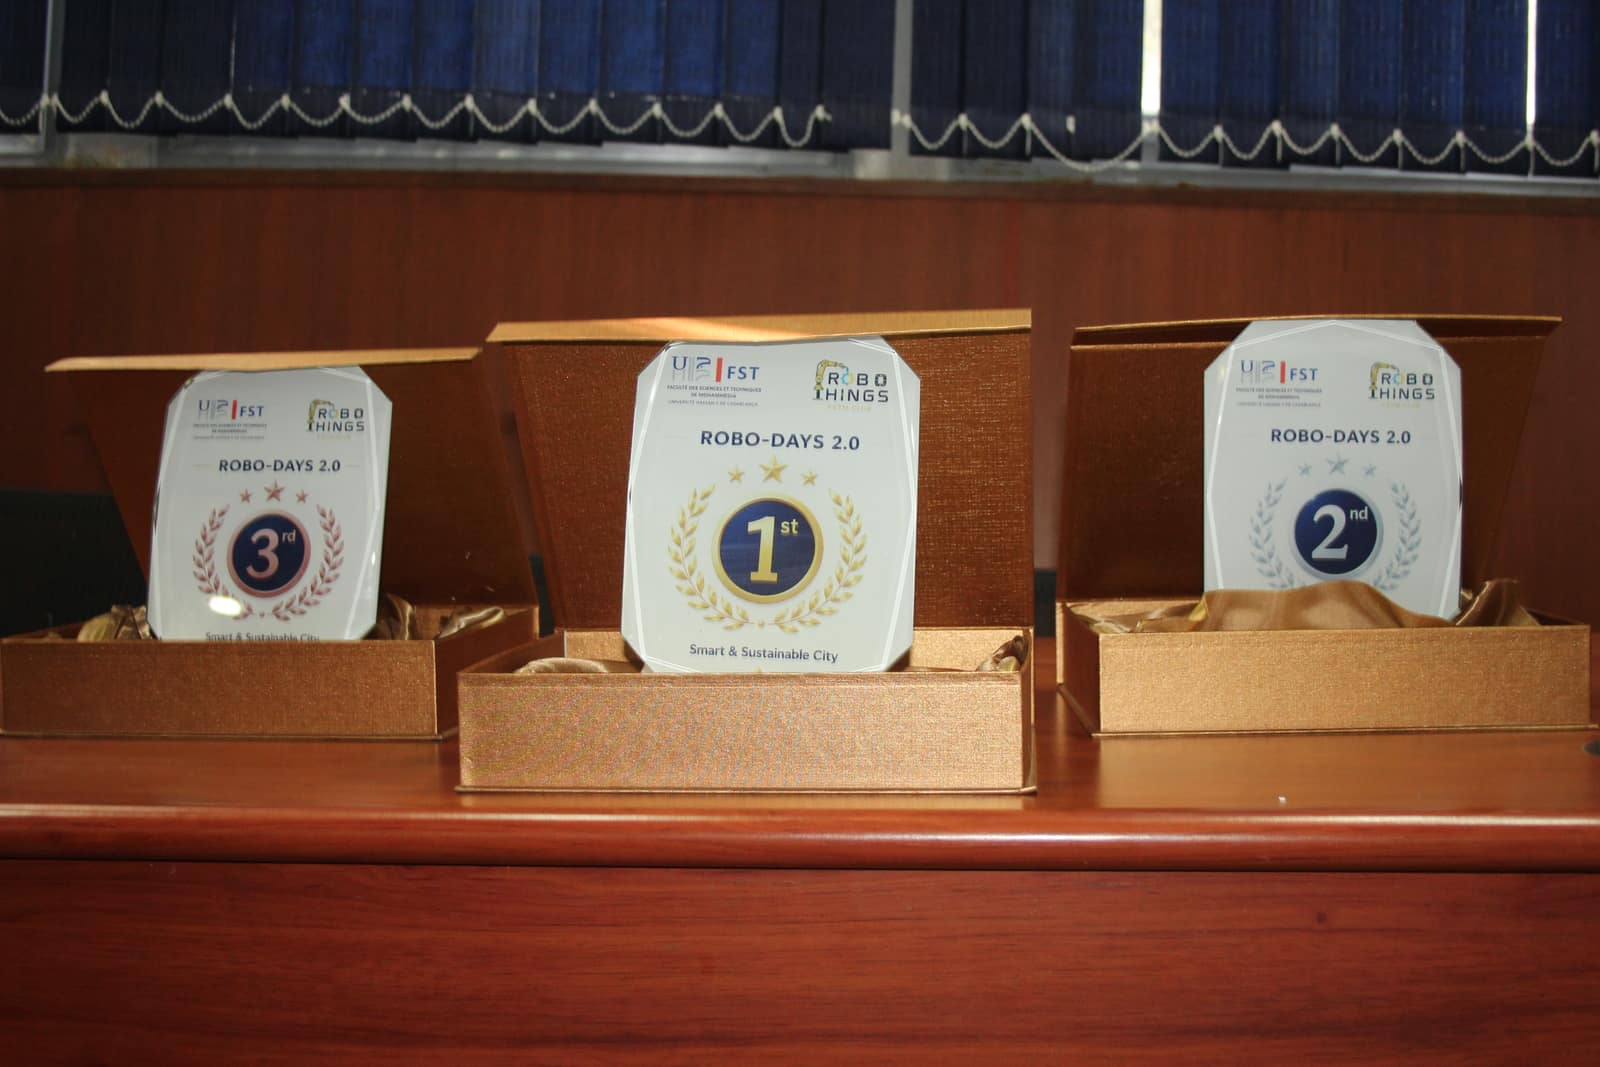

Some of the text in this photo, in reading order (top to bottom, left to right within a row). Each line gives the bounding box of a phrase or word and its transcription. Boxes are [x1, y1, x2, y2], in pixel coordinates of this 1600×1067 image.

[727, 366, 760, 380] FST
[828, 372, 888, 387] ROBO
[1289, 367, 1319, 381] FST
[1381, 373, 1434, 386] ROBO
[815, 387, 889, 403] THINGS
[1370, 387, 1436, 401] THINGS
[240, 406, 265, 417] FST
[318, 408, 364, 419] ROBO
[700, 430, 860, 450] ROBO-DAYS 2.0
[1271, 428, 1411, 444] ROBO-DAYS 2.0
[219, 459, 341, 472] ROBO-DAYS 2.0
[1311, 504, 1369, 559] 2nd
[246, 527, 297, 579] 3rd
[747, 515, 799, 583] 1st
[689, 643, 839, 663] Smart & Sustainable City
